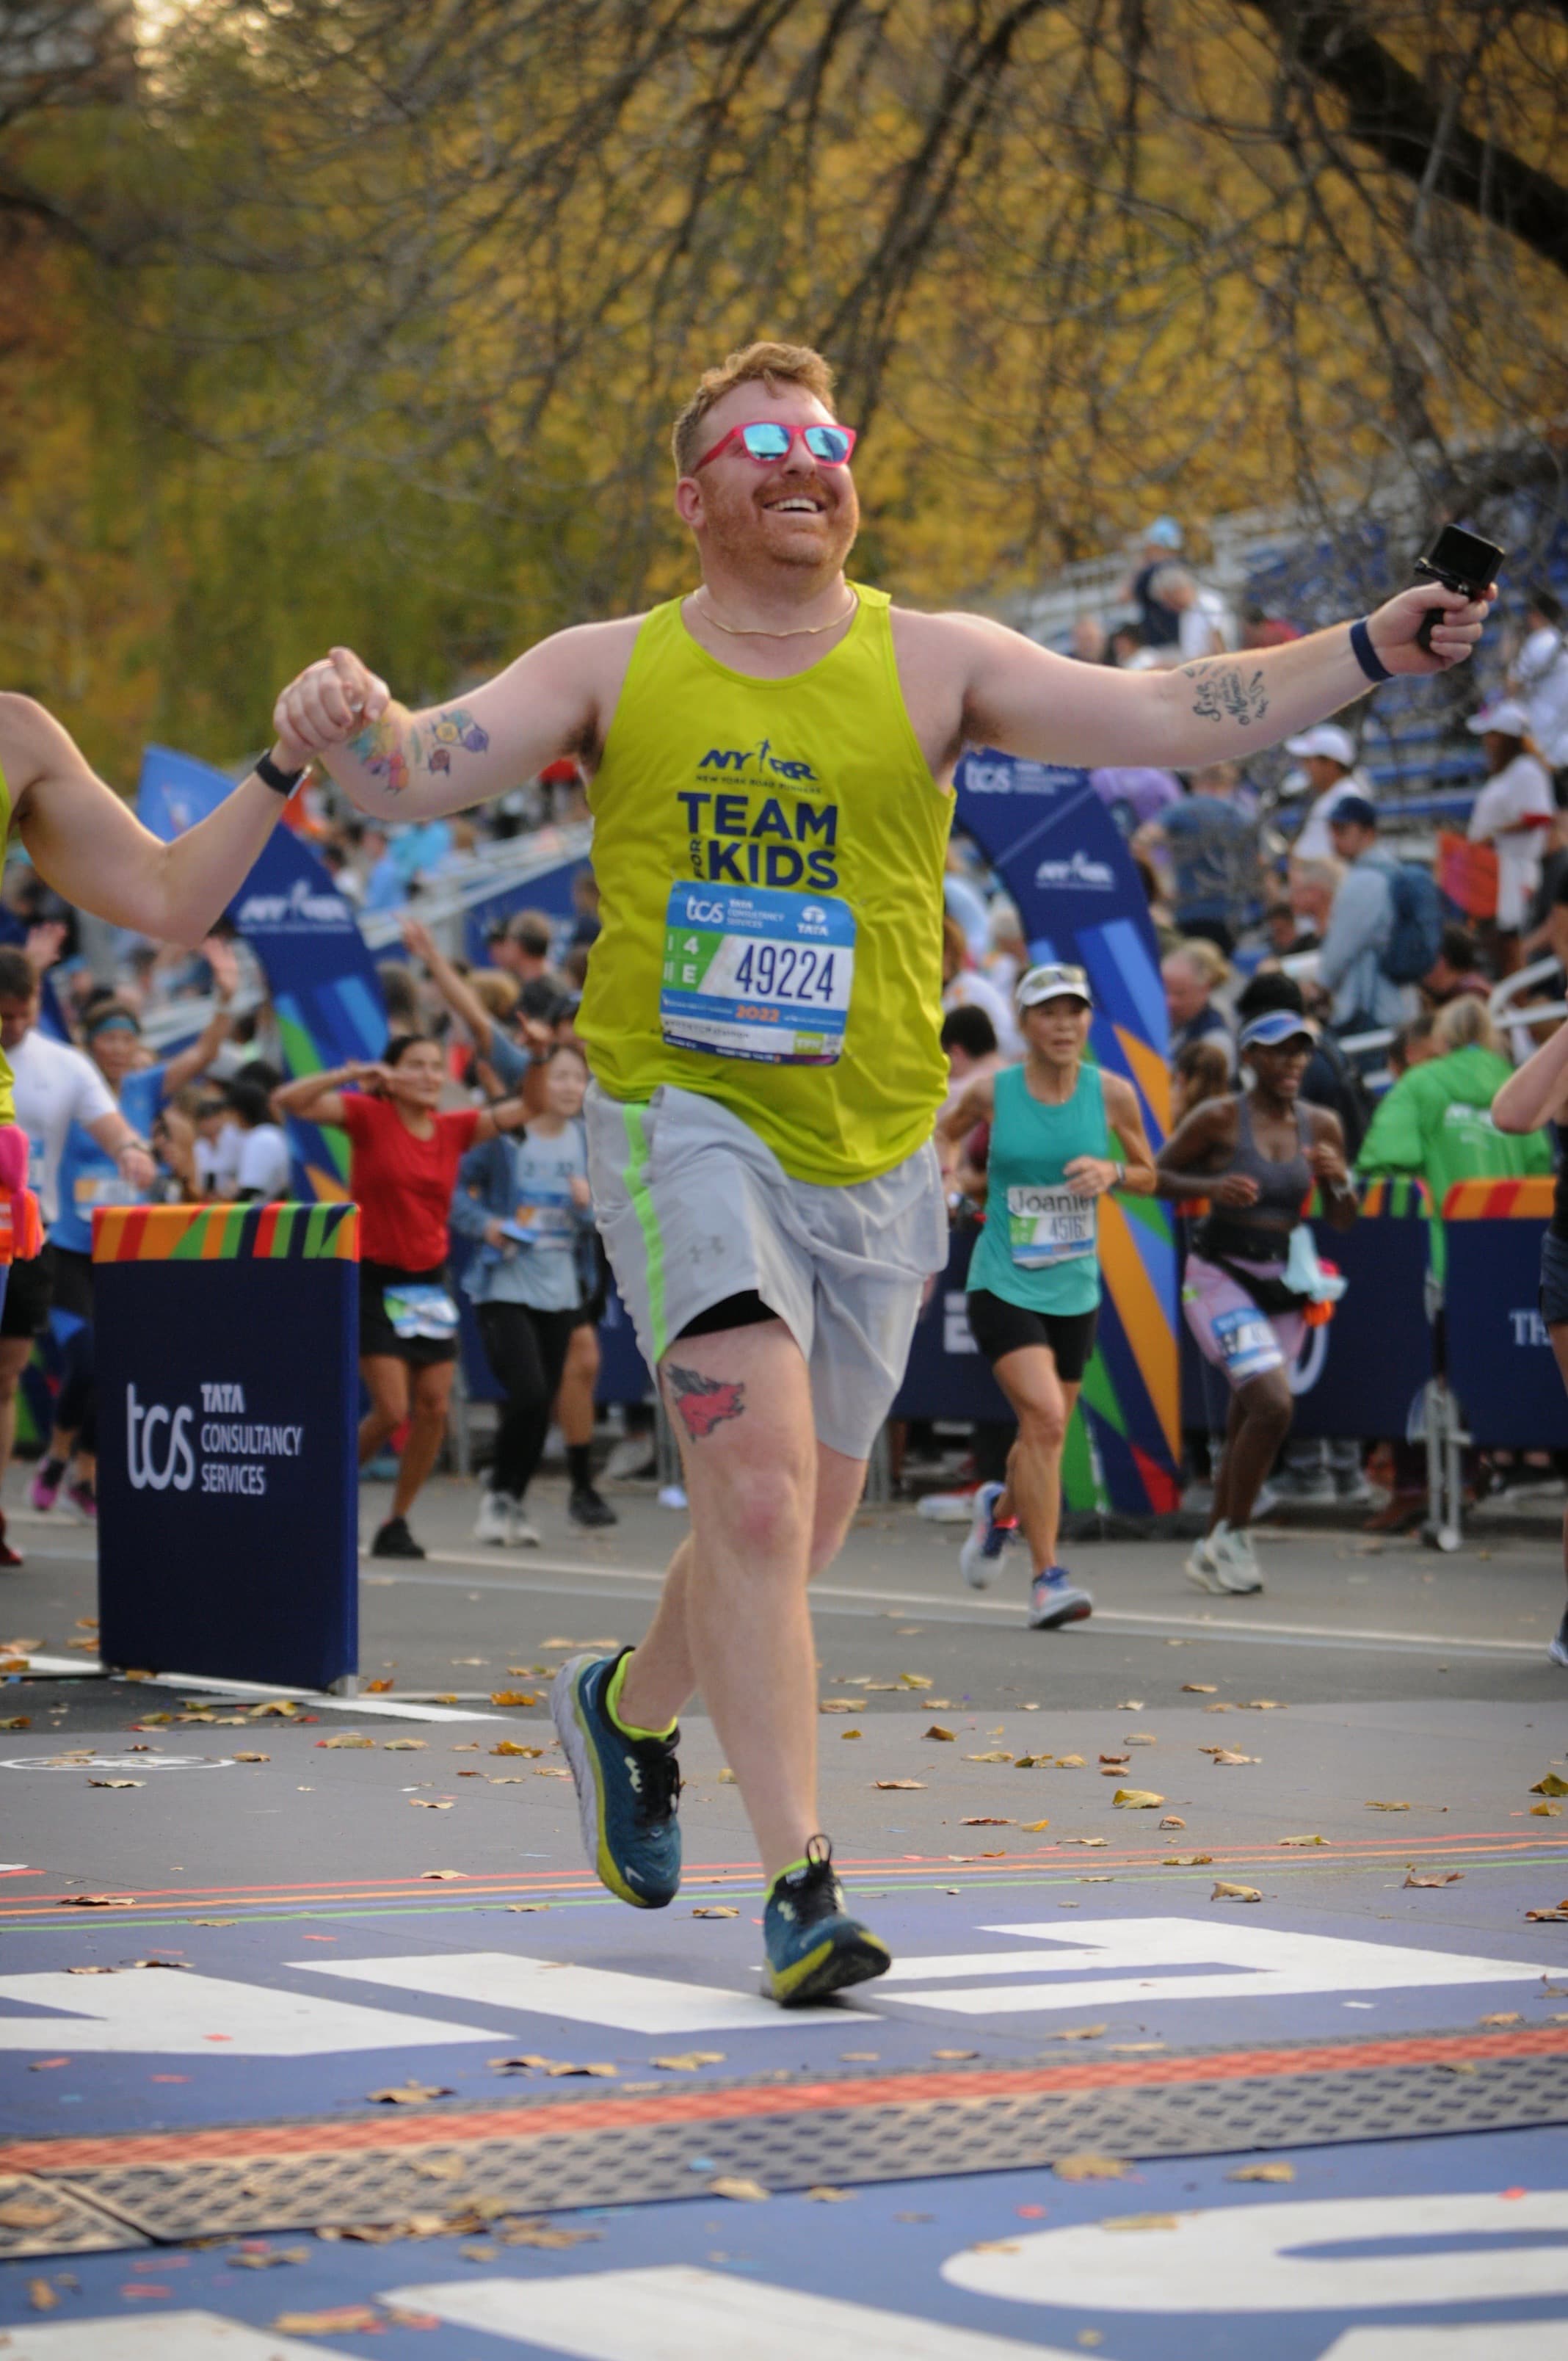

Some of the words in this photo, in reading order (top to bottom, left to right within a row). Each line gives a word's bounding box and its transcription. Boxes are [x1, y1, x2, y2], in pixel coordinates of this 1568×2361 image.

[677, 791, 838, 846] TEAM
[690, 839, 705, 880] FOR
[708, 840, 839, 889] KIDS
[686, 895, 724, 924] tcs
[728, 899, 754, 910] TATA
[683, 935, 700, 955] 4
[796, 923, 829, 937] TATA
[682, 963, 697, 984] E
[735, 943, 835, 1004] 49224
[736, 1004, 780, 1023] 2022
[200, 1383, 245, 1414] TATA
[126, 1382, 195, 1491] tcs
[200, 1423, 303, 1456] CONSULTANCY
[200, 1463, 267, 1495] SERVICES
